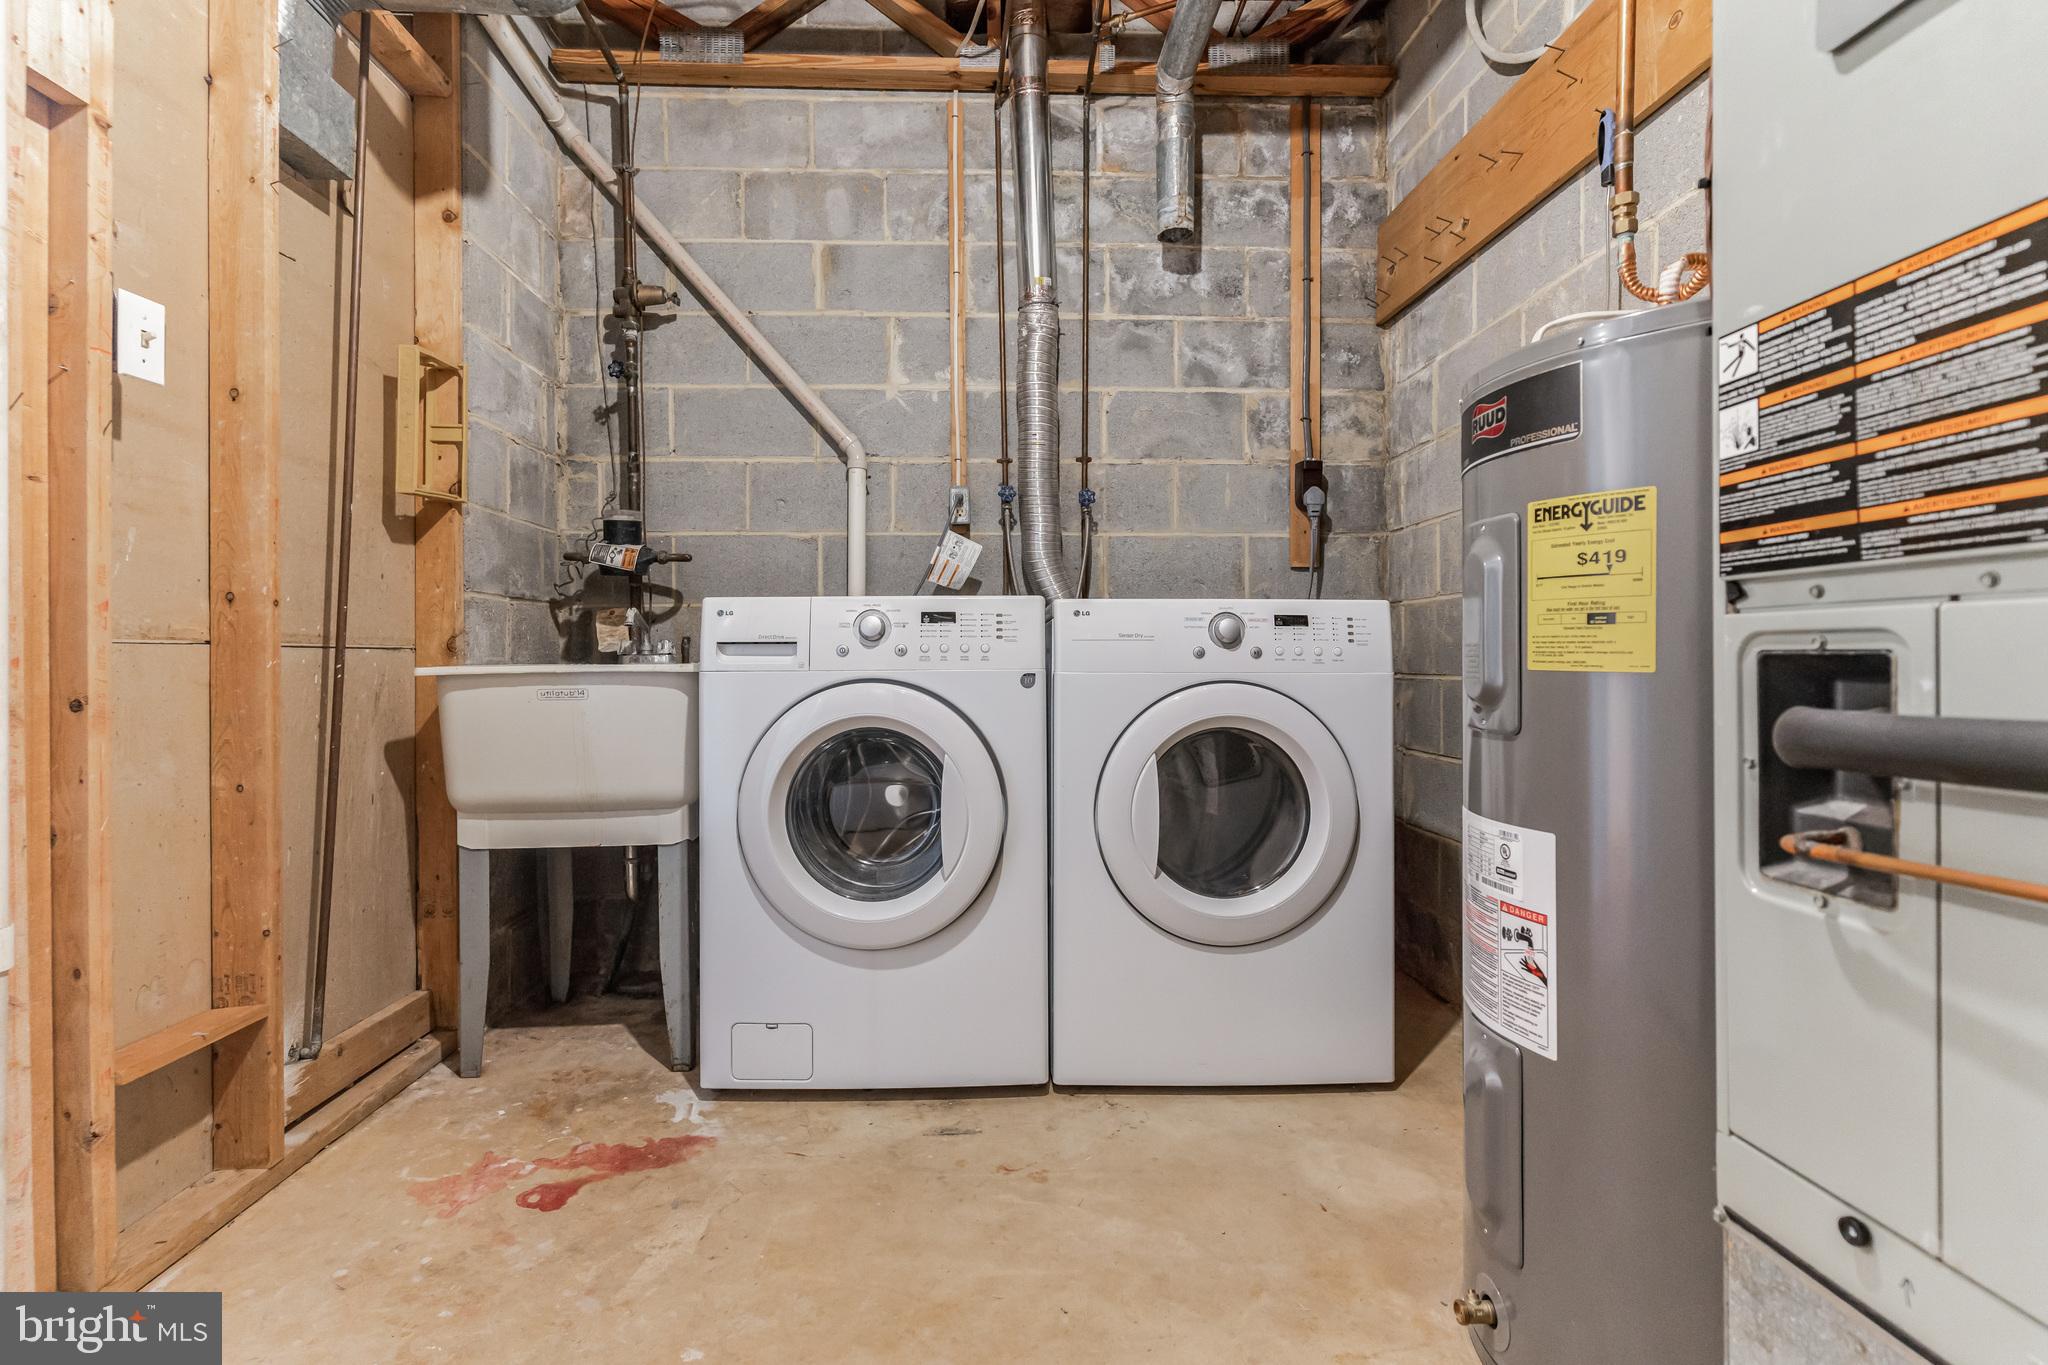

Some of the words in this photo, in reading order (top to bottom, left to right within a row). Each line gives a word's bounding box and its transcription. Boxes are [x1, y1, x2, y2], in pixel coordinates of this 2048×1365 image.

[1472, 406, 1506, 434] RUUD
[1510, 423, 1578, 447] PROFESSIONAL
[1534, 495, 1646, 523] ENERGYGUIDE
[1577, 549, 1627, 567] $419
[1509, 905, 1544, 924] DANGER
